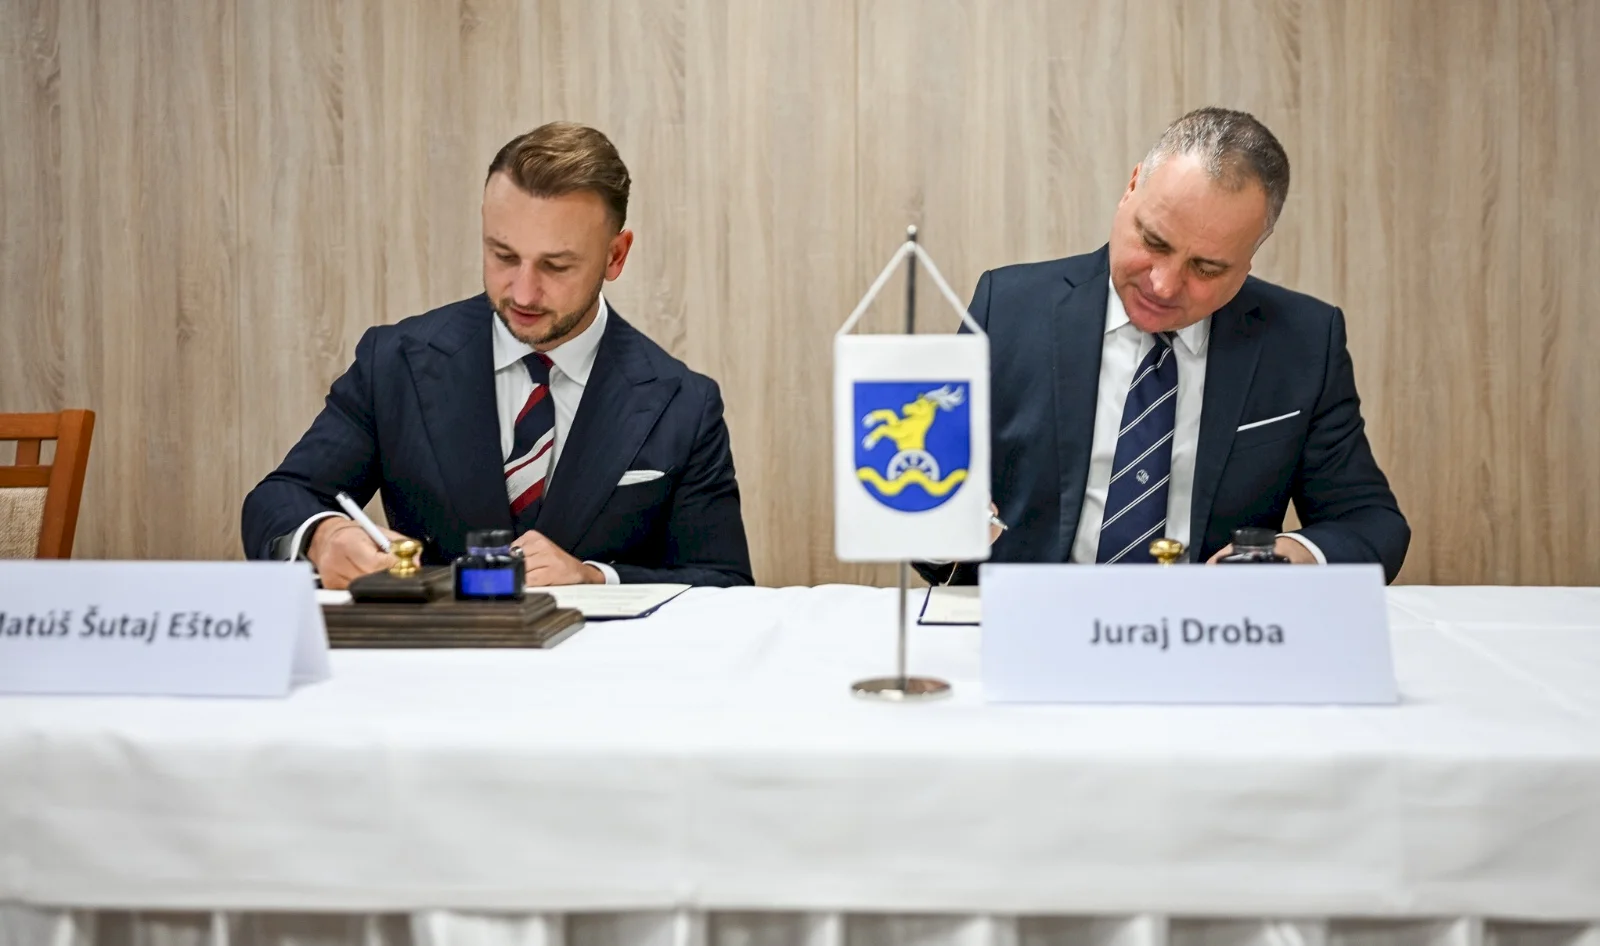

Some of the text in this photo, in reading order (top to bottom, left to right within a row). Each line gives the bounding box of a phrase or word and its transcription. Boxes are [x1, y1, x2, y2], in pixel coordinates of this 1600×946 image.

[78, 605, 159, 645] Šutaj
[167, 611, 253, 640] Eštok
[1090, 617, 1285, 652] Juraj Droba
